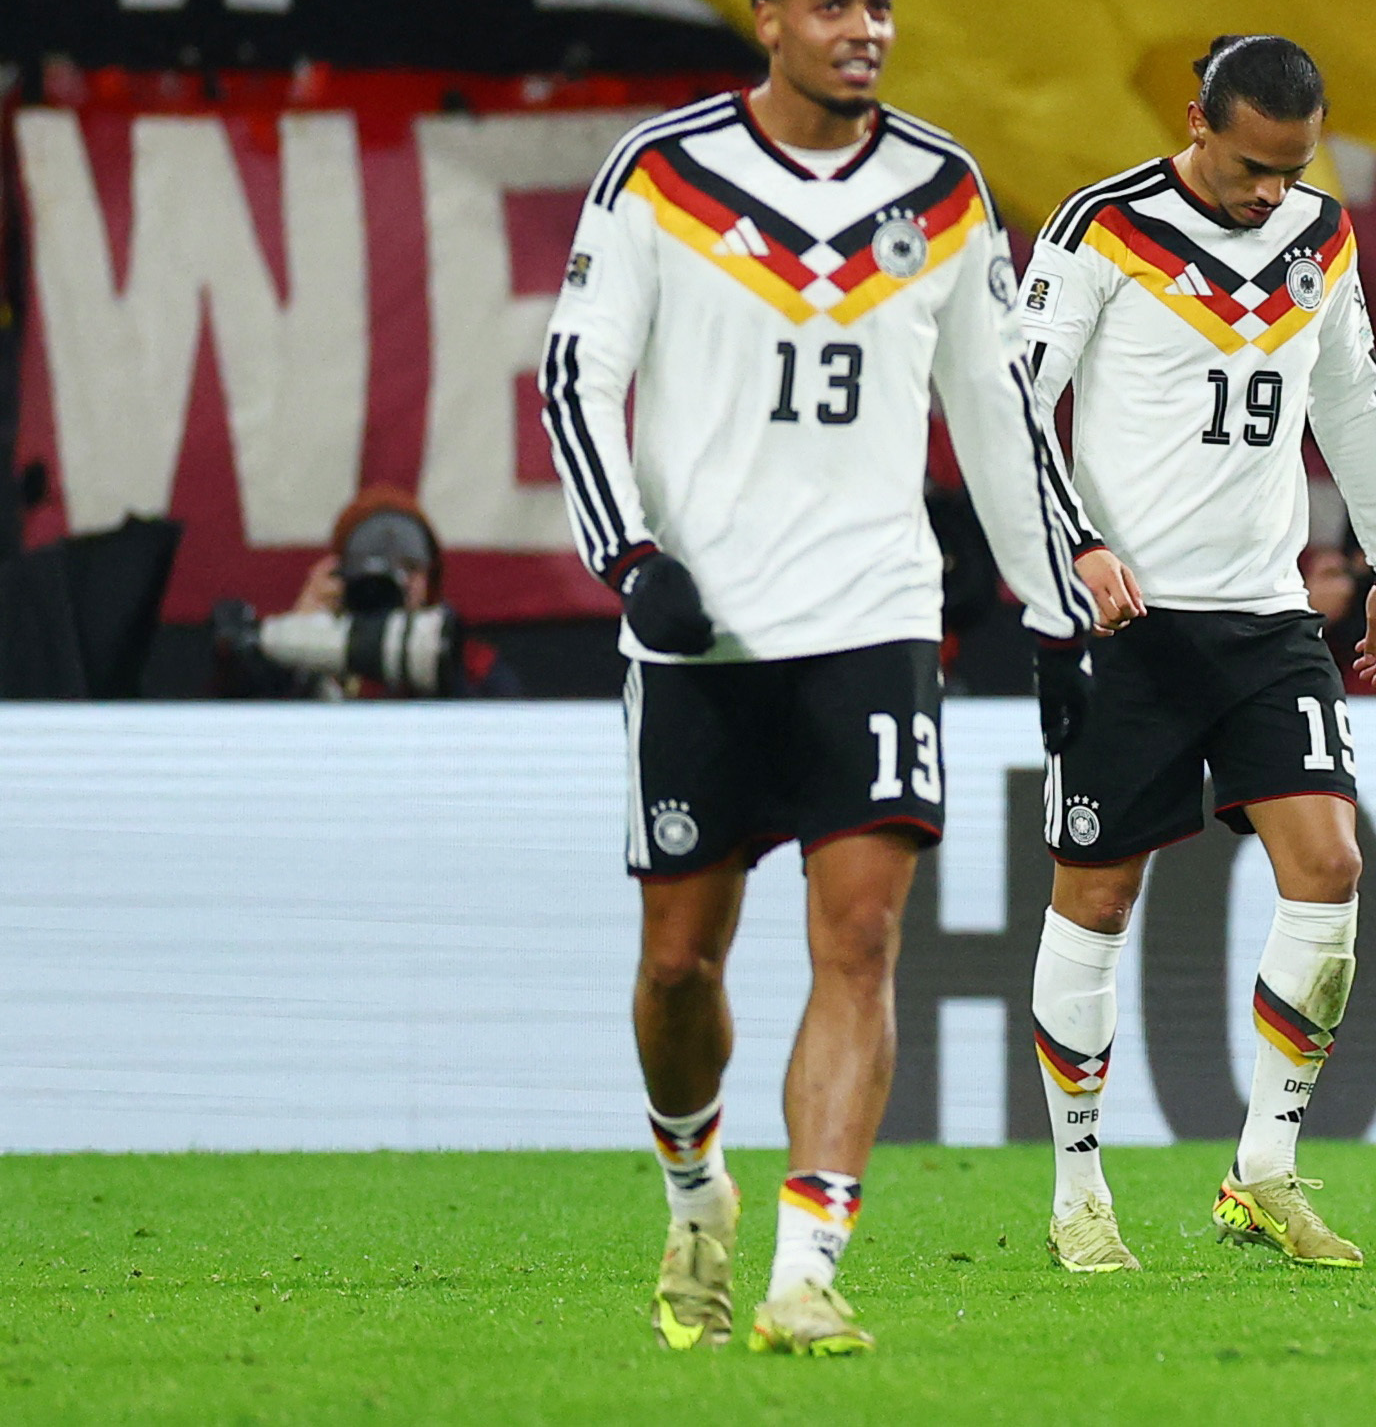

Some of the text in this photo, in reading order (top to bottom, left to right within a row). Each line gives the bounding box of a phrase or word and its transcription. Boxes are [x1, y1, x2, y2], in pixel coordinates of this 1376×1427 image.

[770, 342, 862, 425] 13
[1201, 369, 1283, 447] 19
[869, 711, 942, 805] 13
[1066, 1109, 1099, 1124] DFB
